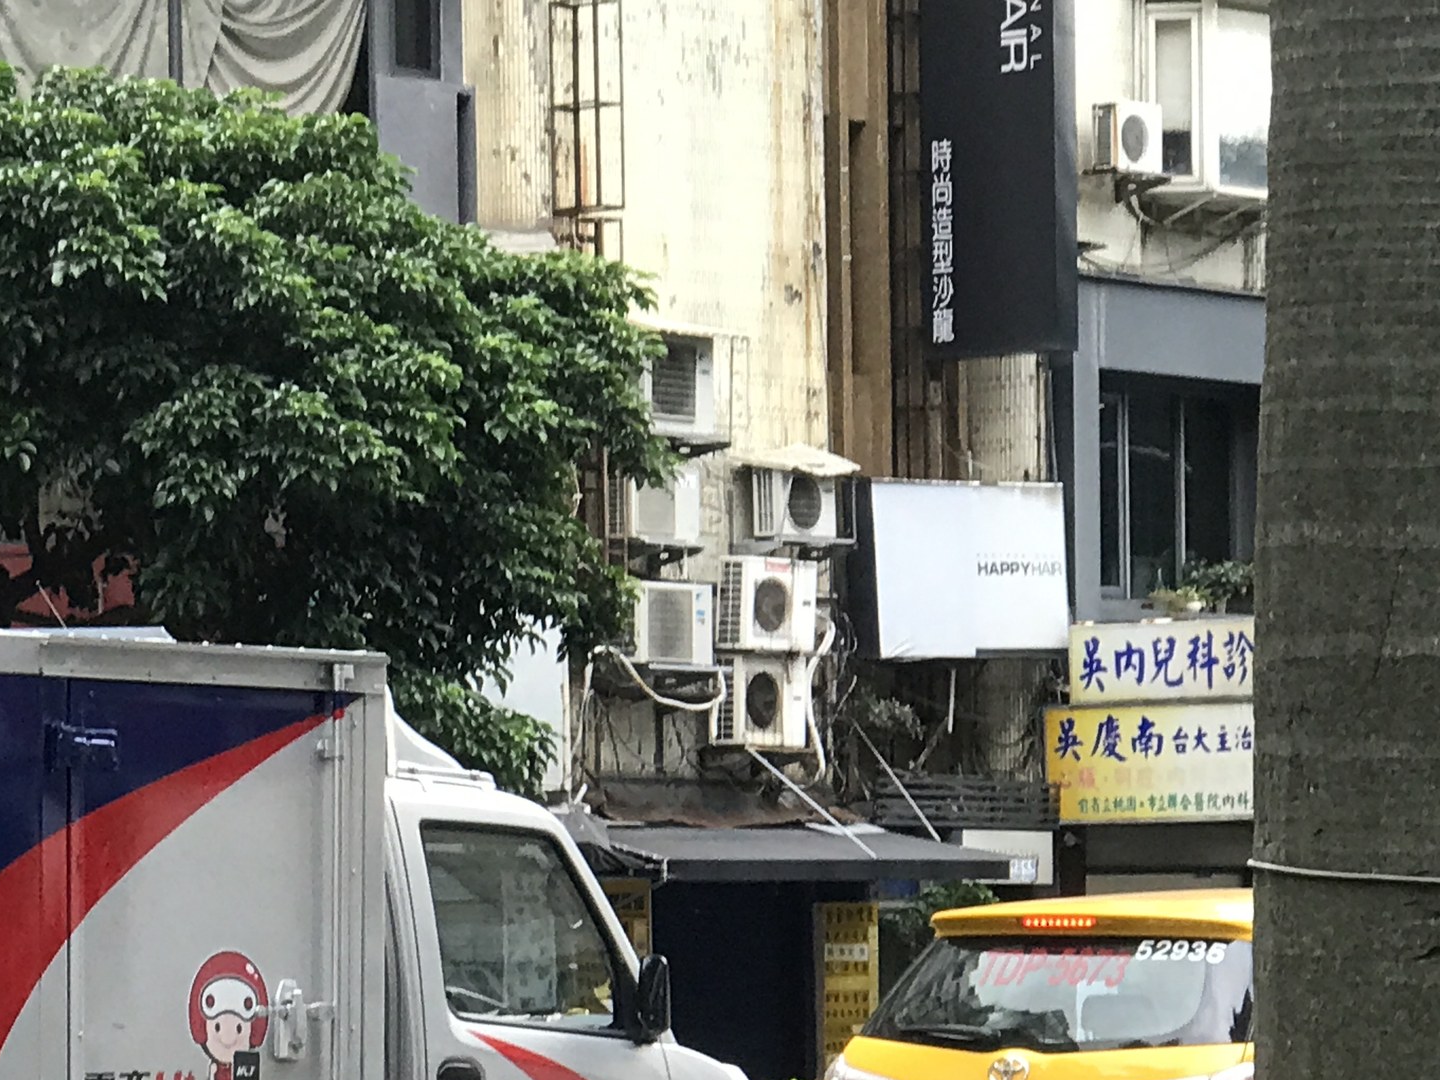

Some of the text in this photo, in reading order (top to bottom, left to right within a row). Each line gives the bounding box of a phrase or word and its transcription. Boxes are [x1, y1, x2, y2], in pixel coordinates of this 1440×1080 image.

[931, 138, 955, 344] 時尚造型沙龍
[1079, 630, 1254, 693] 吳內兒科診
